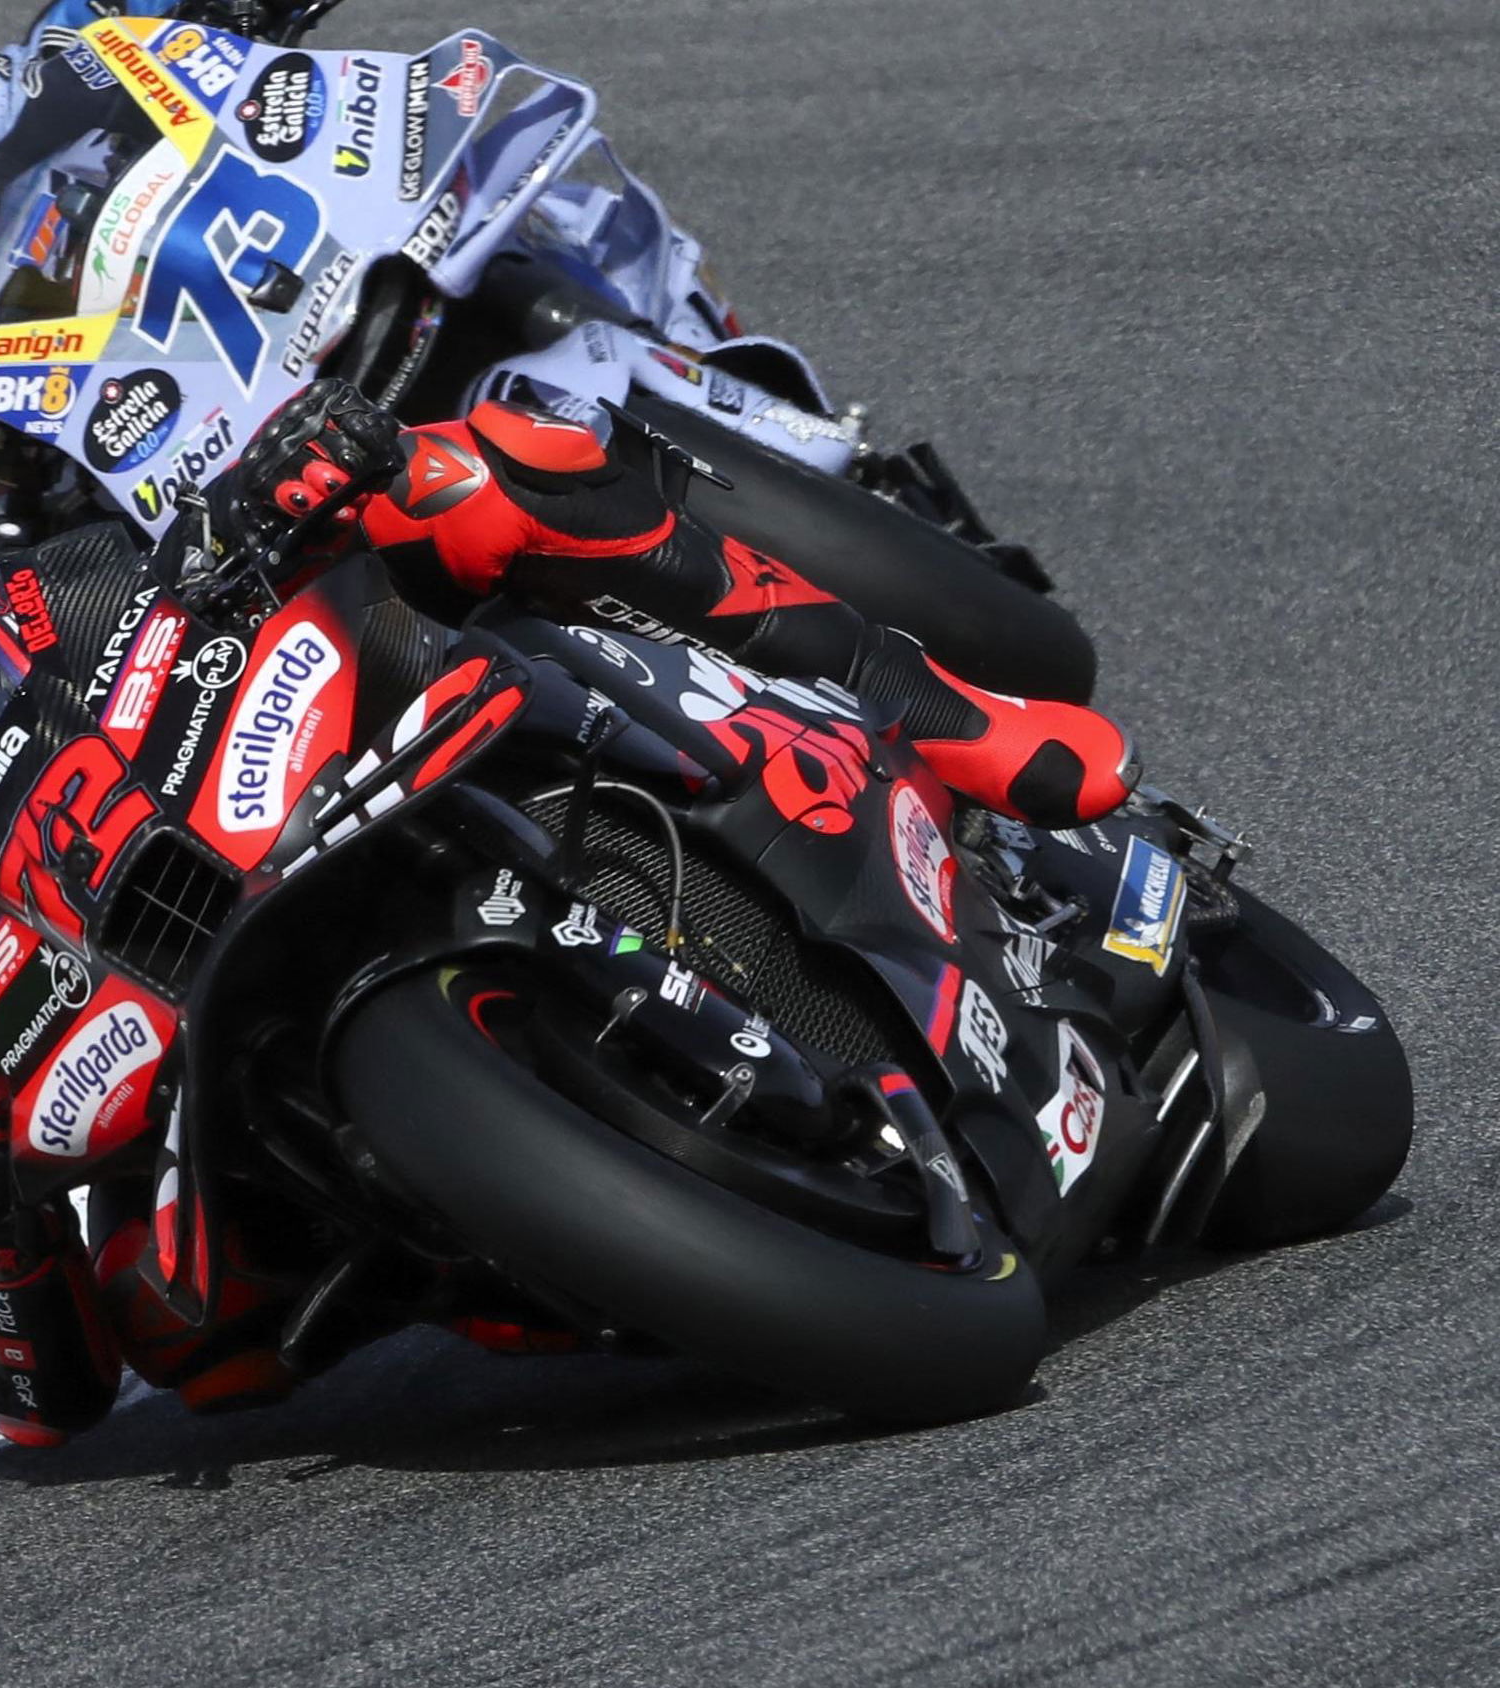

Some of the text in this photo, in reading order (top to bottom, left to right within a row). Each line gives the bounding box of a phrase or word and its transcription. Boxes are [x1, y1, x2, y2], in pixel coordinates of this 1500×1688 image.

[61, 39, 119, 90] ALEX
[94, 29, 200, 127] Antangin
[163, 28, 239, 97] BK8
[256, 70, 289, 146] Estrella
[279, 72, 310, 143] Galicia
[333, 57, 382, 177] Unibat
[404, 114, 424, 171] GLOW
[99, 193, 132, 245] AUS
[111, 172, 175, 256] GLOBAL
[401, 173, 420, 200] MS
[402, 192, 459, 264] BOLD
[131, 145, 326, 400] 73
[24, 421, 64, 435] NEWS
[92, 381, 160, 443] Estrella
[105, 401, 169, 457] Galicia
[131, 416, 235, 522] Unibat
[84, 586, 160, 702] TARGA
[108, 615, 177, 729] BS
[161, 641, 234, 796] PRAGMATIC PLAY
[228, 638, 325, 819] sterilgarda
[290, 706, 323, 773] alimenti
[1140, 852, 1170, 920] MICHELIN
[1, 963, 84, 1075] PRAGMATIC PLAY
[40, 1012, 147, 1150] sterilgarda
[98, 1080, 135, 1129] alimenti
